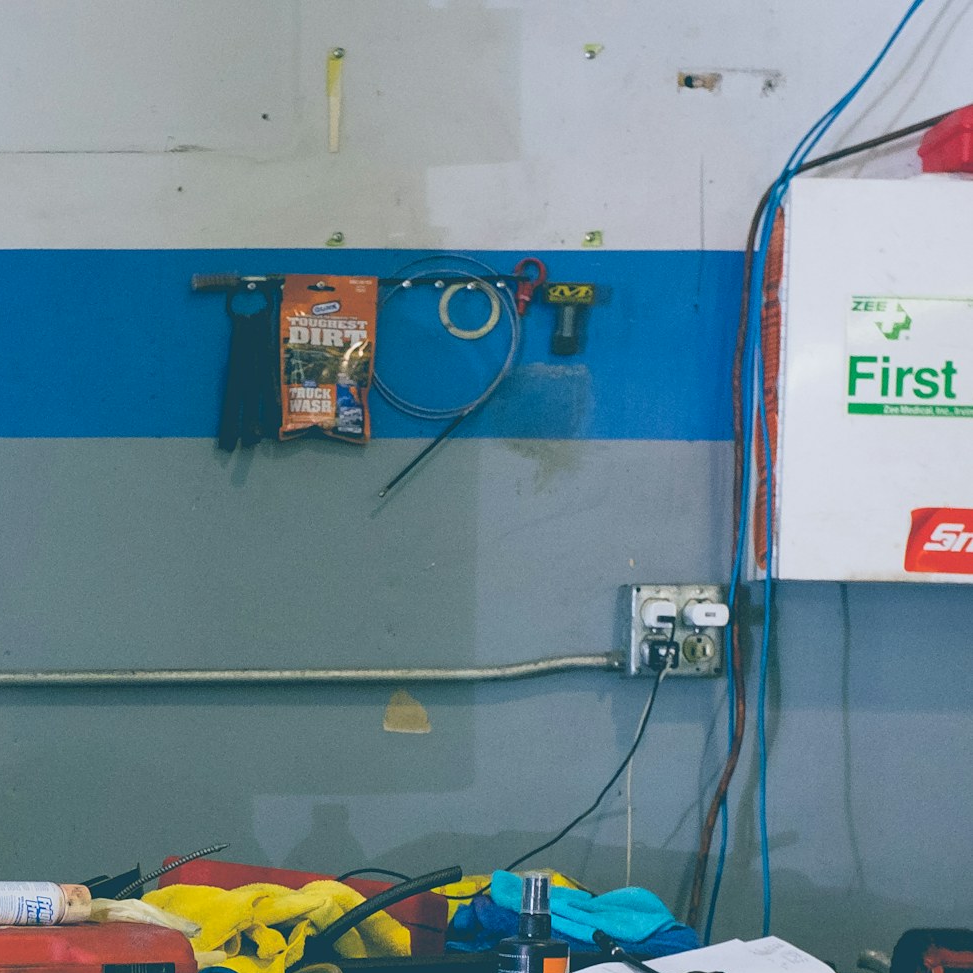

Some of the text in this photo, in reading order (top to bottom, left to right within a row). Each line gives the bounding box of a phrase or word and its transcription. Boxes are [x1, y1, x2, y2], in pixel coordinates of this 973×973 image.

[851, 300, 887, 312] ZEE
[289, 317, 368, 330] TOUGHEST
[288, 326, 368, 347] DIRT
[847, 355, 958, 399] First
[289, 387, 332, 399] TRUCK
[289, 399, 332, 413] WASH
